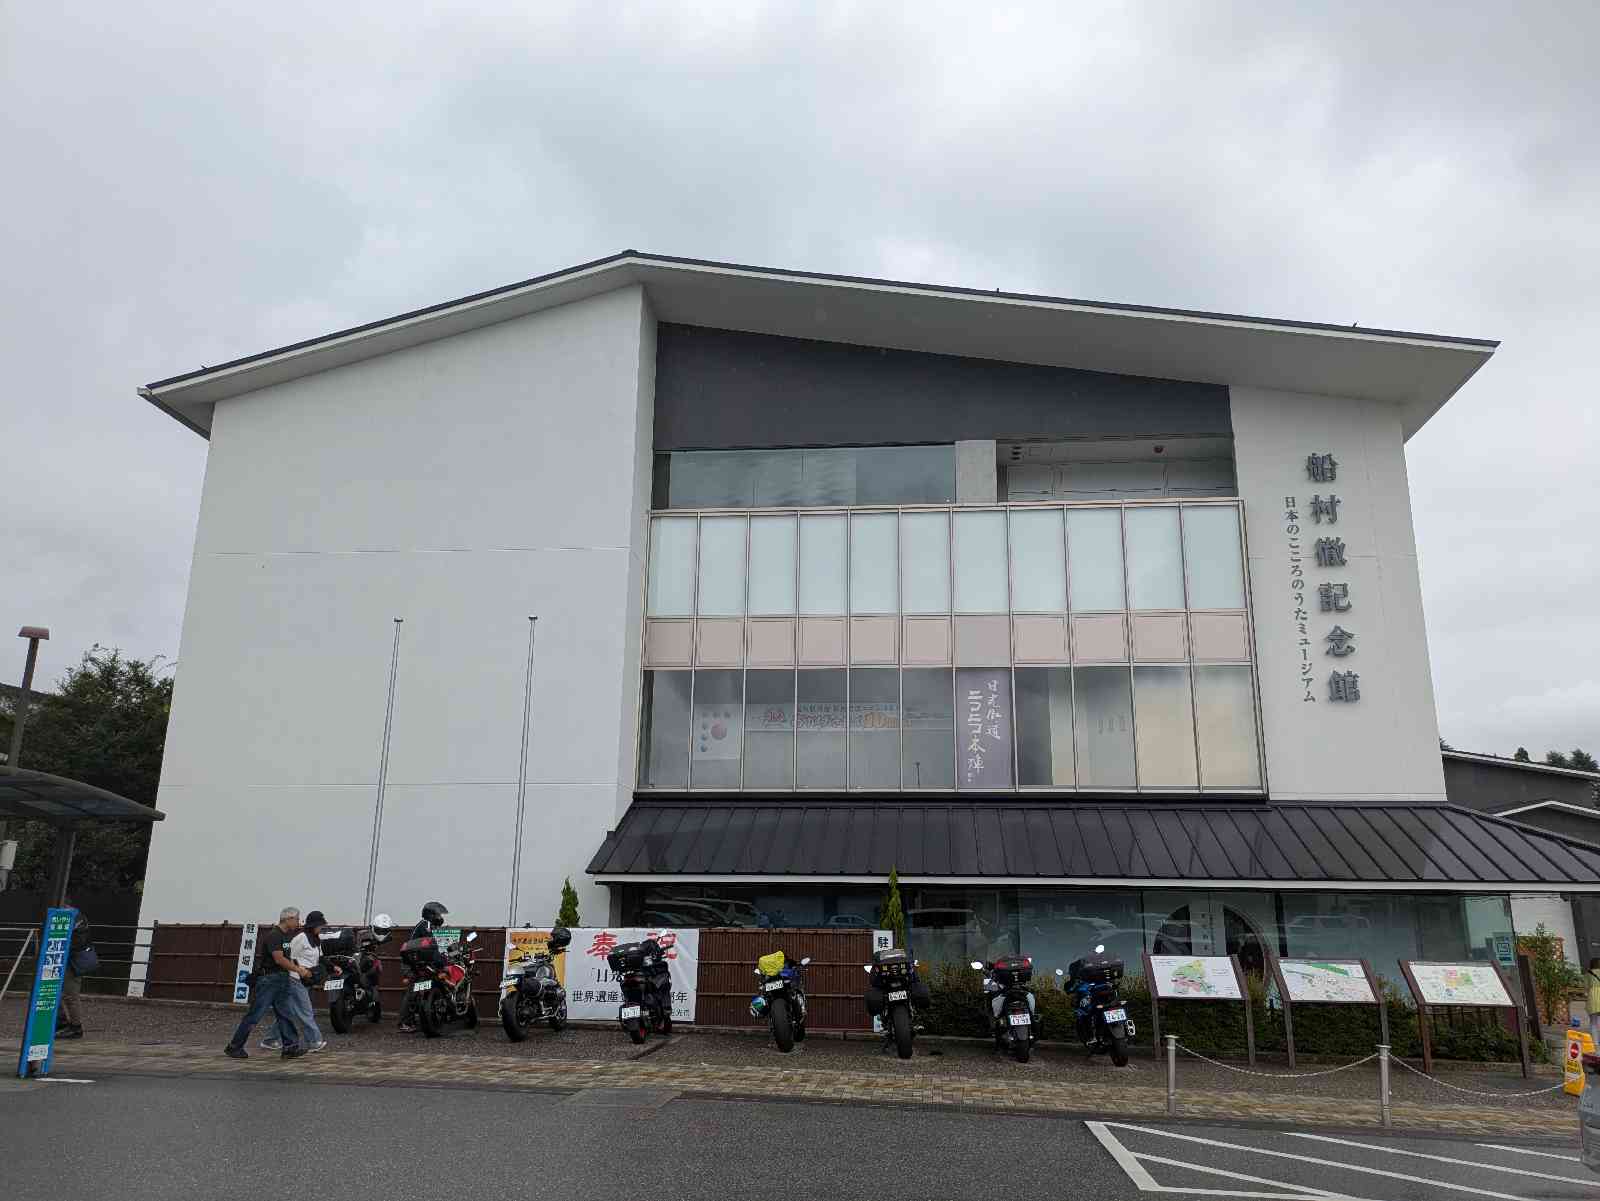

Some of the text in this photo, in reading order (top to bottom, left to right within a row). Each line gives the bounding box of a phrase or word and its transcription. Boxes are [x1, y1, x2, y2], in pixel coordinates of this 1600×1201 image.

[1285, 496, 1316, 702] 日本のこころのうたミュージアム
[1306, 453, 1360, 703] 船村徹記念館
